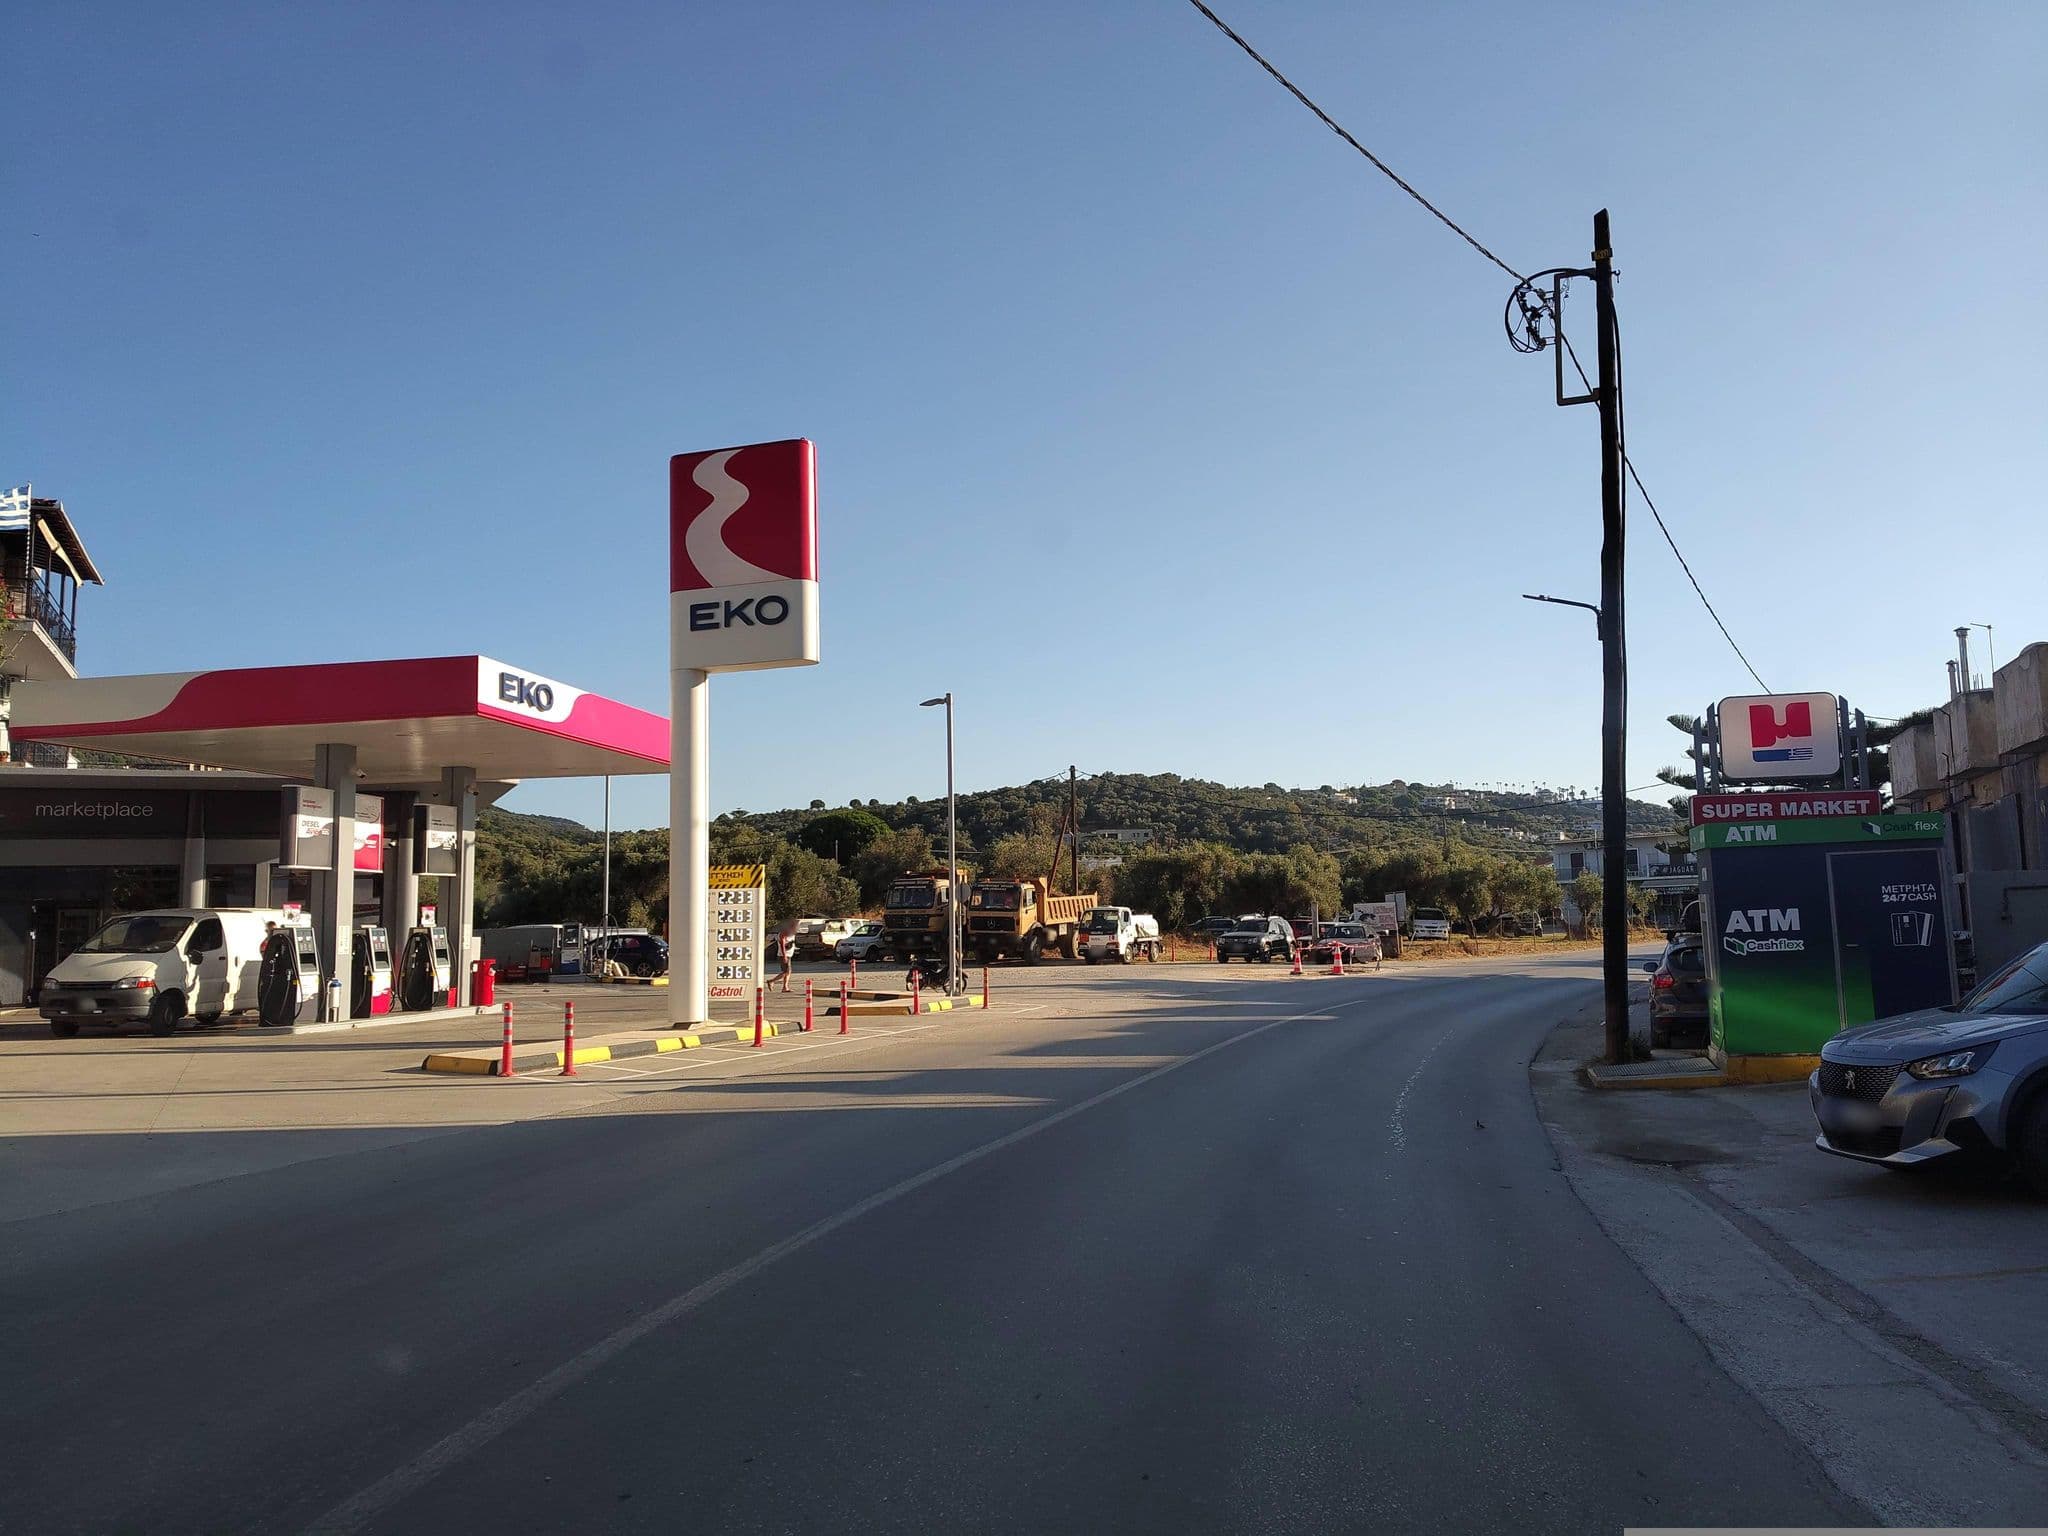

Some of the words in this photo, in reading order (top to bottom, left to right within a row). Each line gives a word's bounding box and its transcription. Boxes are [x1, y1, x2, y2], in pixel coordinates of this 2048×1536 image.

[690, 595, 789, 631] EKO
[499, 672, 554, 712] EKO
[35, 802, 153, 820] marketplace
[1702, 803, 1773, 818] SUPER
[1780, 800, 1870, 816] MARKET
[1725, 825, 1777, 842] ATM
[1883, 821, 1939, 833] Cashflex
[1881, 883, 1936, 893] ΜΕΤΡΗΤΑ
[718, 891, 753, 904] 2.233
[1882, 893, 1907, 902] 24/7
[1907, 892, 1937, 901] CASH
[718, 909, 752, 923] 2.283
[1725, 908, 1800, 933] ATM
[718, 928, 752, 941] 2.443
[1746, 938, 1804, 951] Cashflex
[717, 947, 752, 960] 2.292
[717, 966, 752, 979] 2.362
[710, 986, 743, 997] Castrol
